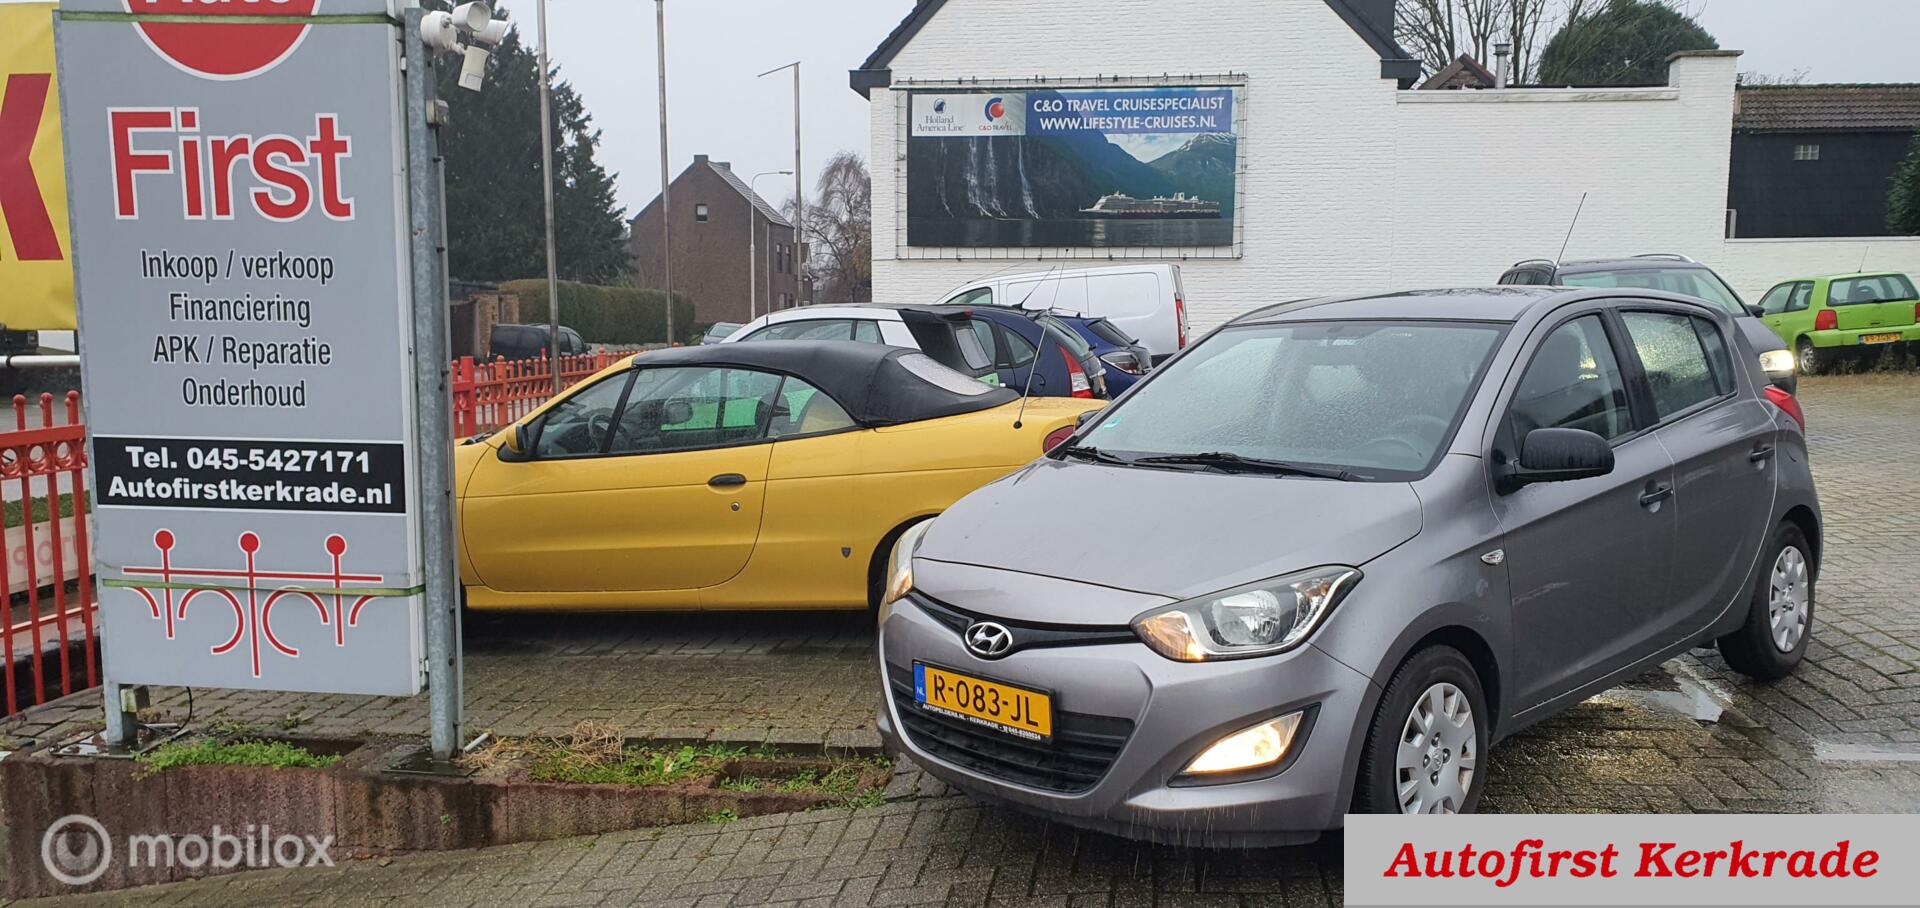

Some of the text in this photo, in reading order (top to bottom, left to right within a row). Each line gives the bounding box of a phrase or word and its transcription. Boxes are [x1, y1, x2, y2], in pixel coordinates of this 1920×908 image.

[925, 115, 954, 123] Holland
[1033, 97, 1225, 112] C&O TRAVEL CRUISESPECIALIST
[916, 123, 964, 131] America Line
[1040, 115, 1217, 130] WWW.LIFESTYLE-CRUISES.NL
[107, 106, 355, 222] First
[141, 250, 335, 284] Inkoop / verkoop
[169, 293, 312, 328] Financiering
[152, 335, 332, 370] APK / Reparatie
[182, 378, 306, 408] Onderhoud
[125, 446, 370, 474] Tel. 045-5427171
[108, 475, 392, 506] Autofirstkerkrade.nl
[916, 686, 925, 697] NL
[934, 674, 1039, 727] R-083-JL
